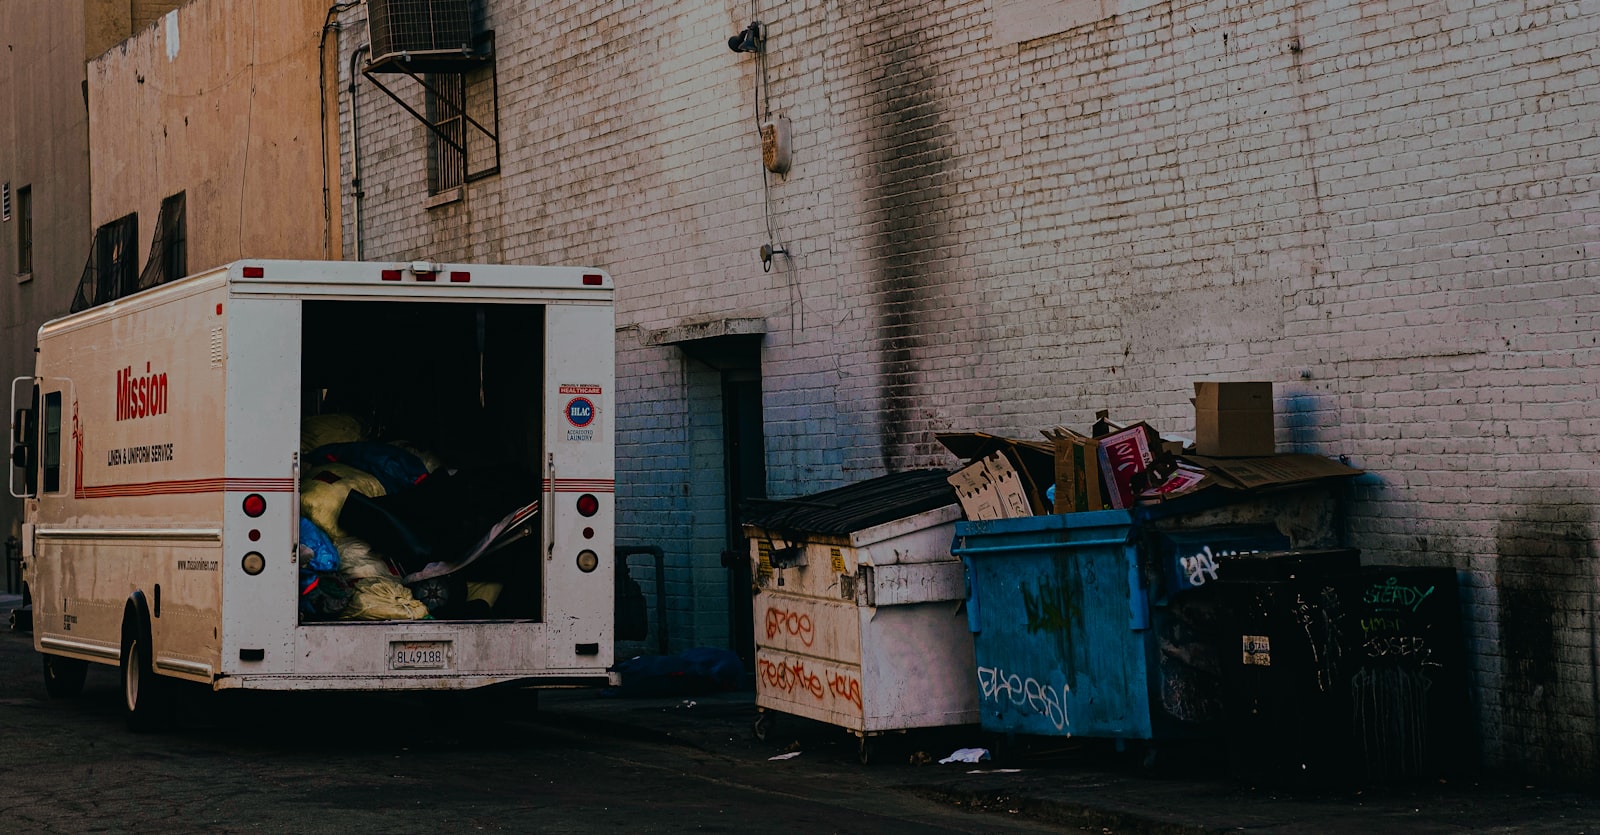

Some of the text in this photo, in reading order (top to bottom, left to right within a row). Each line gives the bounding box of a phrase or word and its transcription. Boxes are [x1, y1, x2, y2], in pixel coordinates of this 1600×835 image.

[116, 361, 168, 421] Mission
[571, 407, 590, 416] HLAC
[107, 443, 173, 466] LINEN & UNIFORM SERVICE
[397, 651, 441, 663] 8L49188
